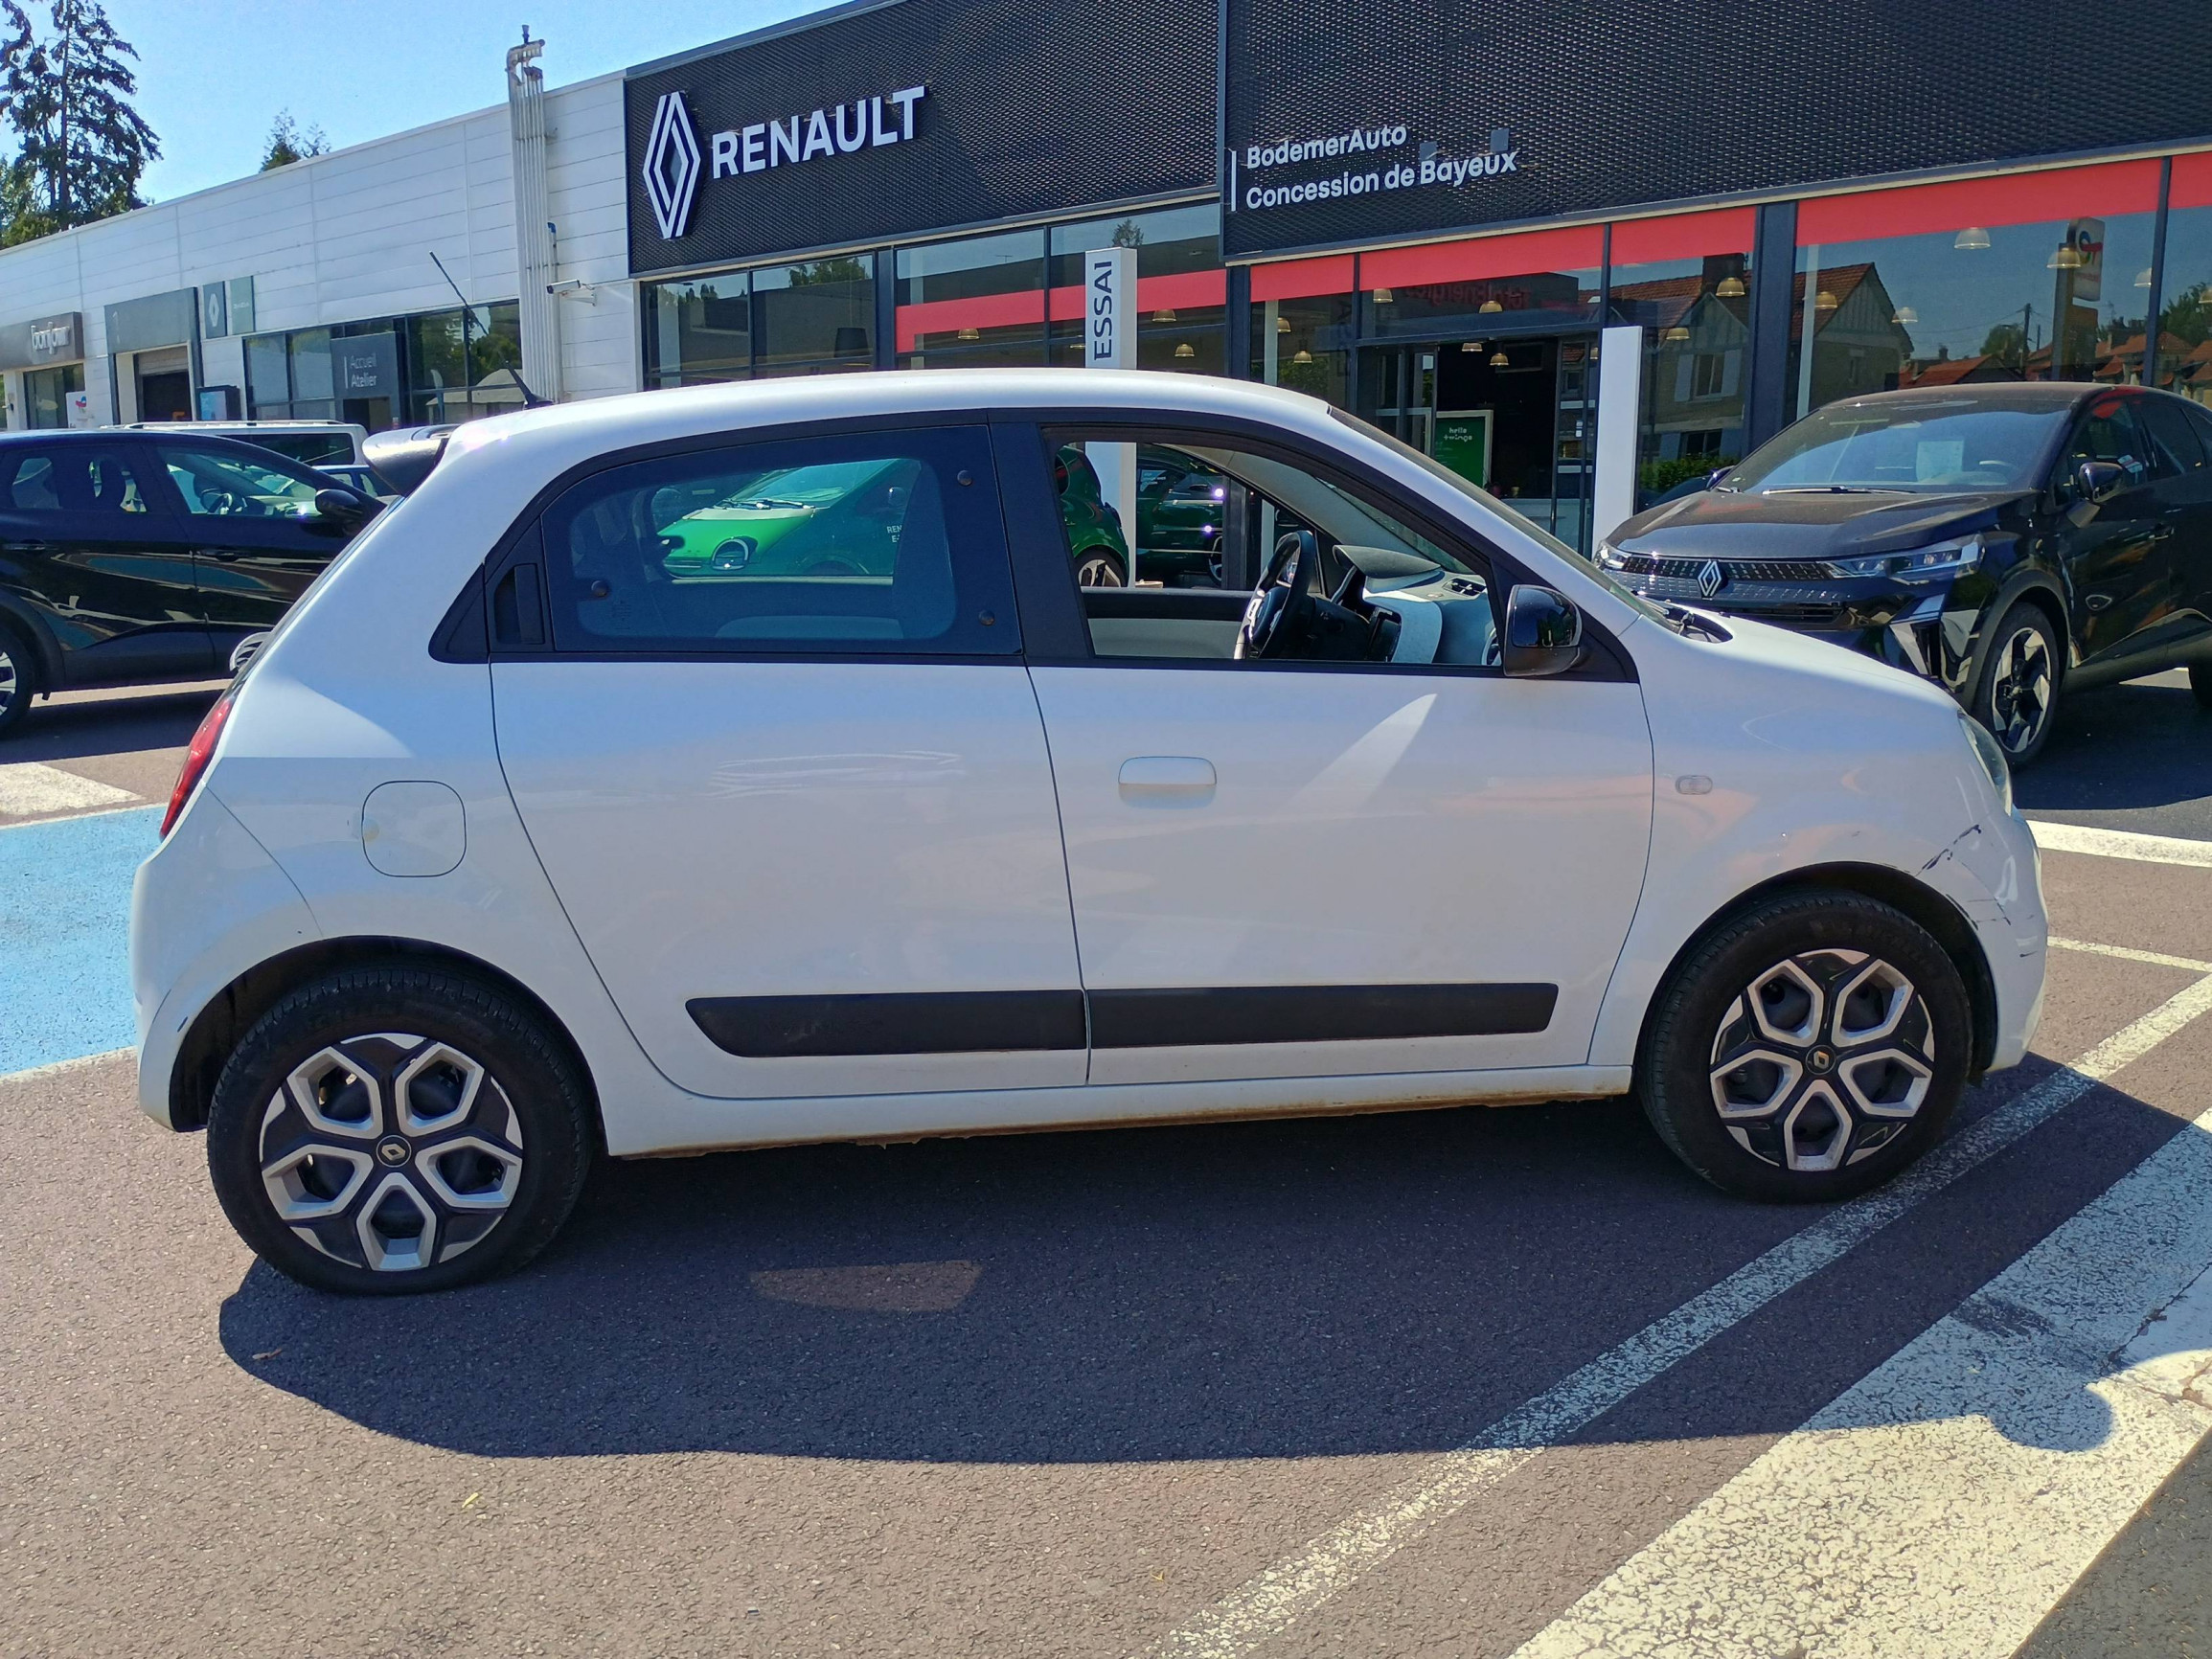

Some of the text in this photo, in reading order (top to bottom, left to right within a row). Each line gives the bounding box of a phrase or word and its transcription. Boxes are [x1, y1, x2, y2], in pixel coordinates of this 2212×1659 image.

[712, 85, 925, 179] RENAULT
[1246, 125, 1407, 169] BodemerAuto
[1245, 151, 1517, 209] Concession de Bayeux
[1093, 261, 1113, 361] ESSAI
